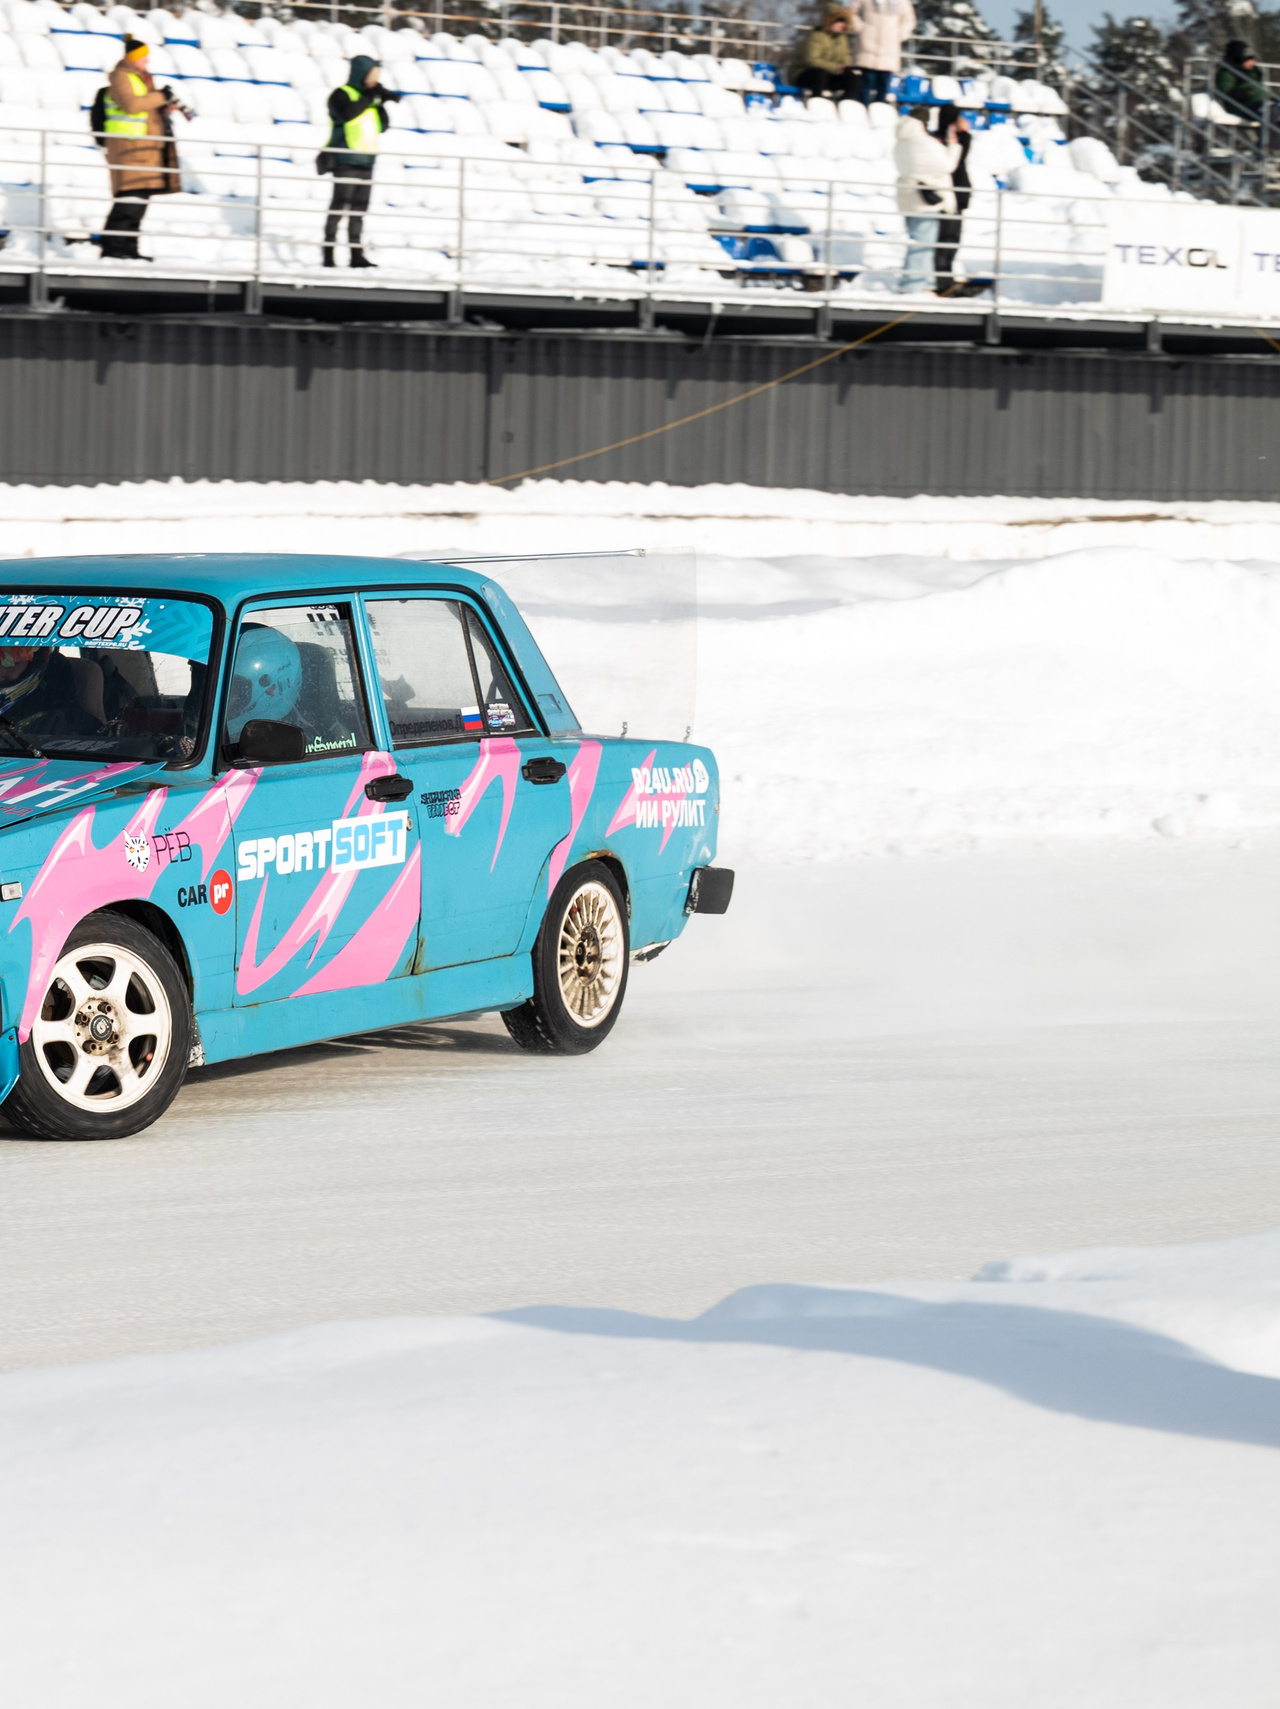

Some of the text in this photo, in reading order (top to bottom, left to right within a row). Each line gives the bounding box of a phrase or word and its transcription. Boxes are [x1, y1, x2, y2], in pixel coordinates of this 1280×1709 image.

[60, 606, 142, 640] CUP
[631, 767, 694, 793] B24U.RU
[662, 799, 706, 827] РУЛИТ
[152, 827, 192, 865] РЁВ
[177, 882, 229, 907] CAR pr
